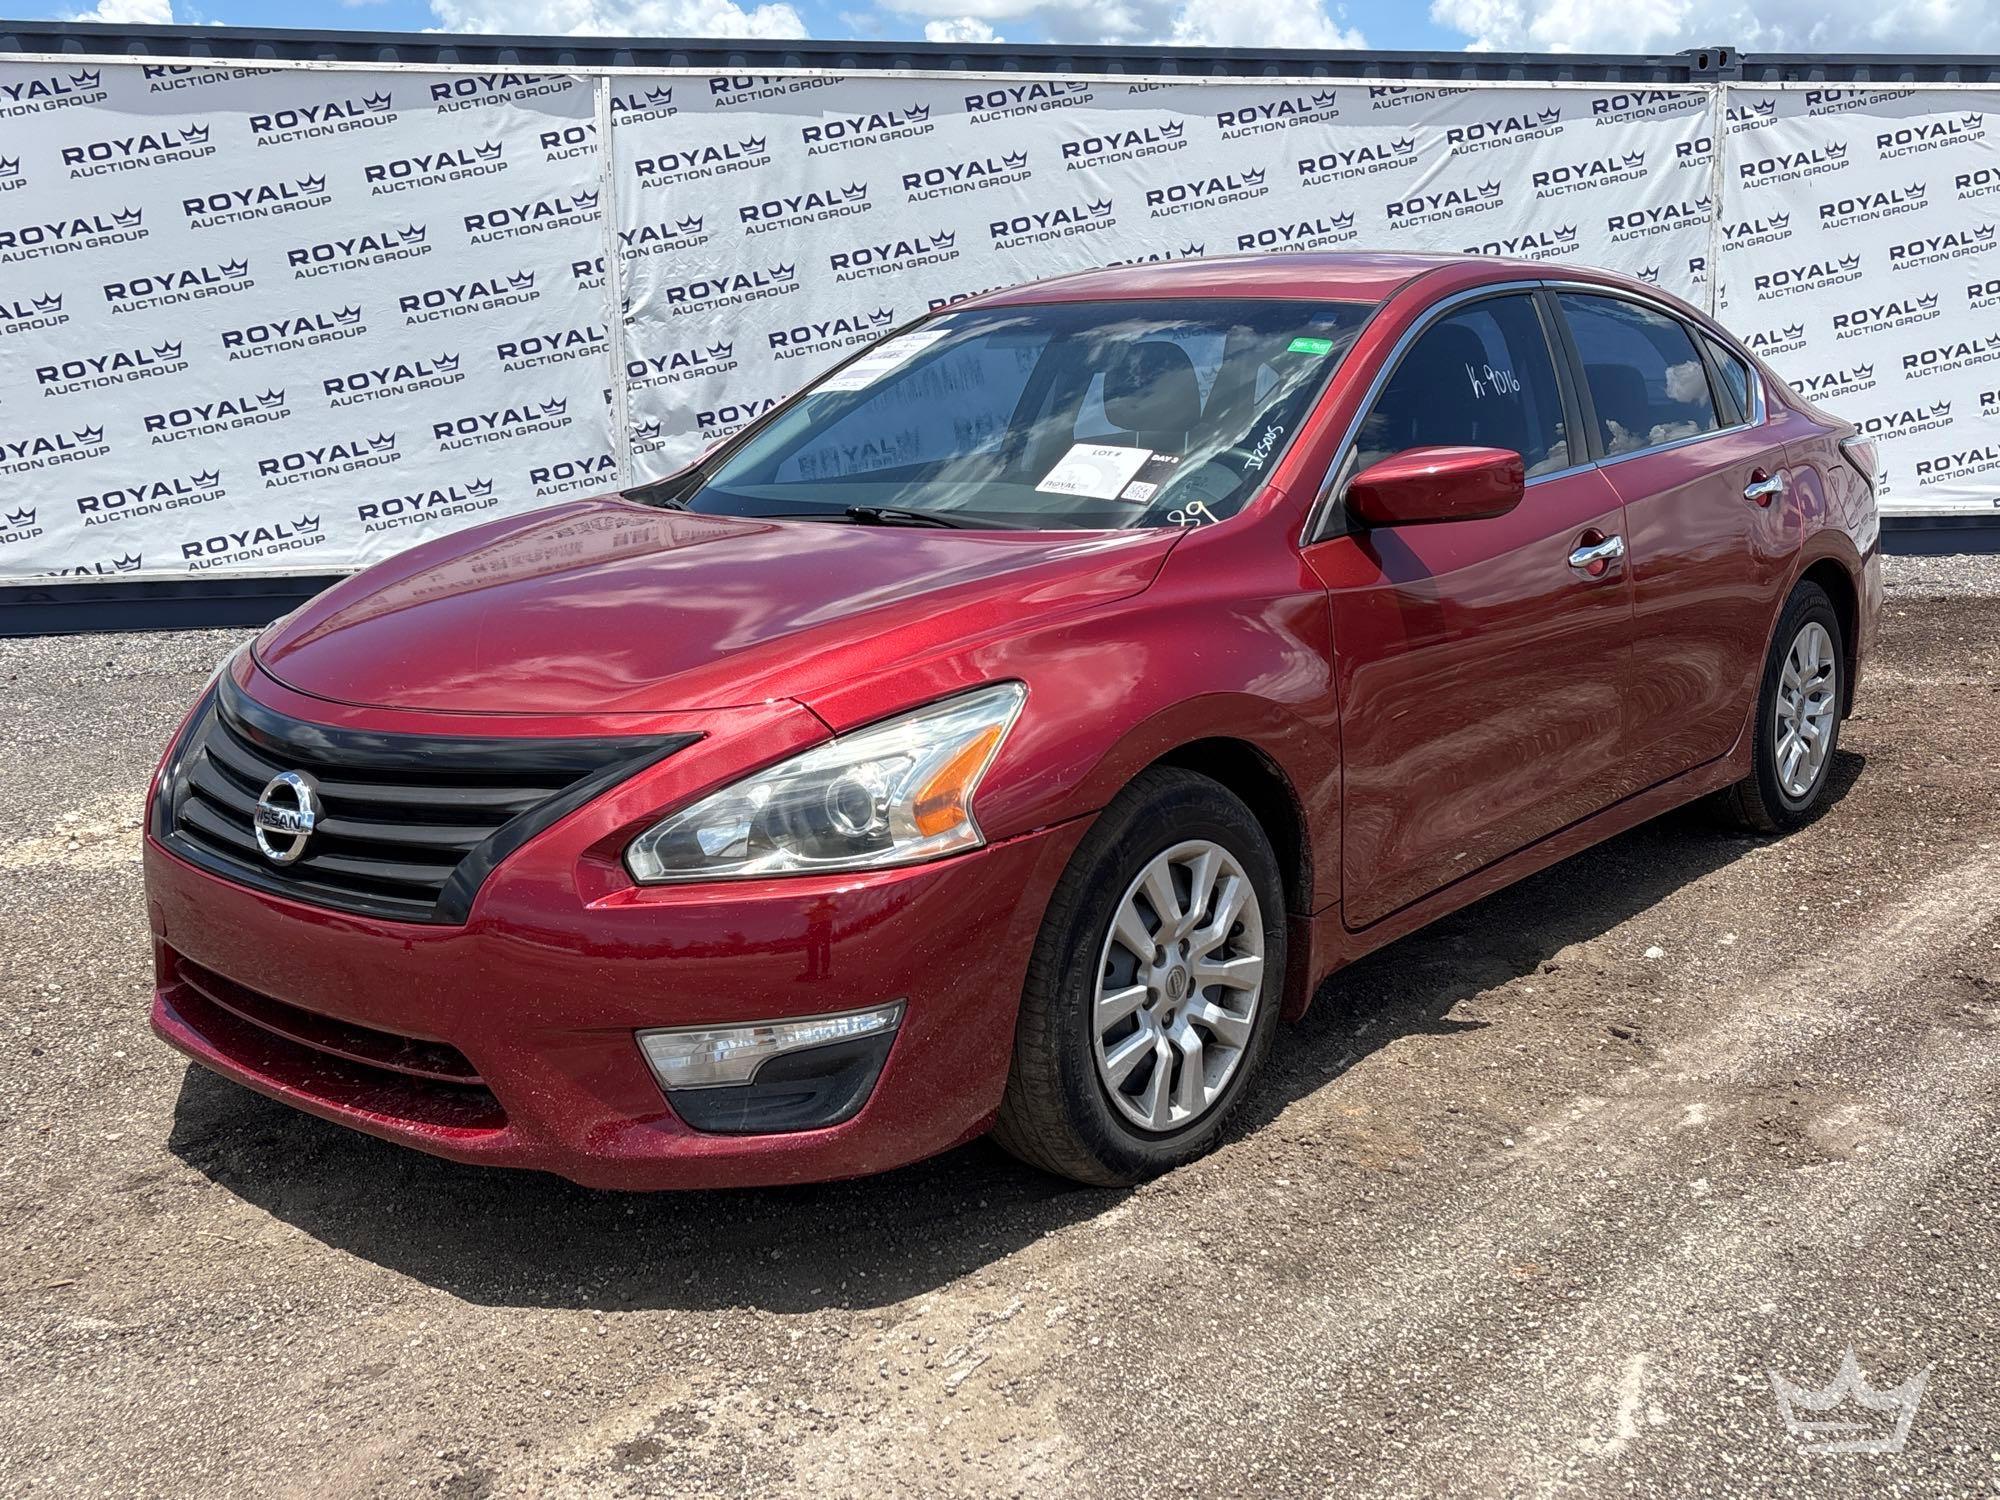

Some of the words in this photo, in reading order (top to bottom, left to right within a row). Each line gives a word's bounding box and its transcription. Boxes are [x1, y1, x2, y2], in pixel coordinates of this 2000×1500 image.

[43, 92, 108, 111] GROUP
[437, 93, 511, 114] AUCTION
[515, 81, 572, 99] GROUP
[715, 86, 787, 107] AUCTION
[965, 81, 1065, 112] ROYAL
[970, 104, 1037, 125] AUCTION
[1040, 94, 1093, 111] GROUP
[1596, 107, 1656, 126] AUCTION
[1659, 97, 1706, 113] GROUP
[1809, 98, 1867, 117] AUCTION
[250, 100, 364, 133] ROYAL
[802, 112, 904, 144] ROYAL
[1217, 98, 1312, 128] ROYAL
[1222, 121, 1286, 140] AUCTION
[1289, 110, 1339, 127] GROUP
[258, 125, 334, 147] AUCTION
[338, 114, 397, 132] GROUP
[808, 135, 877, 156] AUCTION
[880, 124, 934, 142] GROUP
[1062, 128, 1160, 159] ROYAL
[1447, 115, 1537, 145] ROYAL
[1450, 137, 1512, 157] AUCTION
[1515, 126, 1563, 143] GROUP
[1877, 121, 1961, 149] ROYAL
[1880, 141, 1937, 160] AUCTION
[1940, 131, 1985, 147] GROUP
[61, 132, 182, 166] ROYAL
[70, 157, 150, 179] AUCTION
[153, 146, 216, 164] GROUP
[635, 144, 740, 176] ROYAL
[1067, 151, 1132, 171] AUCTION
[1136, 140, 1187, 157] GROUP
[1298, 145, 1391, 175] ROYAL
[1740, 150, 1826, 178] ROYAL
[364, 149, 476, 183] ROYAL
[372, 174, 446, 196] AUCTION
[449, 162, 508, 180] GROUP
[641, 168, 712, 189] AUCTION
[715, 156, 771, 174] GROUP
[902, 159, 1003, 190] ROYAL
[1302, 167, 1365, 187] AUCTION
[1368, 156, 1418, 173] GROUP
[1533, 158, 1622, 188] ROYAL
[1743, 171, 1801, 189] AUCTION
[1804, 160, 1849, 176] GROUP
[183, 183, 298, 216] ROYAL
[908, 182, 975, 203] AUCTION
[979, 171, 1031, 188] GROUP
[1146, 175, 1242, 206] ROYAL
[1536, 180, 1597, 199] AUCTION
[1600, 169, 1647, 185] GROUP
[191, 208, 268, 229] AUCTION
[271, 196, 331, 214] GROUP
[464, 199, 573, 232] ROYAL
[739, 190, 842, 223] ROYAL
[1151, 198, 1215, 218] AUCTION
[1218, 187, 1269, 204] GROUP
[1386, 188, 1478, 219] ROYAL
[1390, 210, 1452, 230] AUCTION
[1455, 200, 1503, 216] GROUP
[1608, 202, 1695, 232] ROYAL
[1819, 190, 1904, 219] ROYAL
[1822, 211, 1880, 230] AUCTION
[1883, 200, 1928, 216] GROUP
[471, 223, 543, 245] AUCTION
[746, 214, 814, 235] AUCTION
[818, 203, 871, 220] GROUP
[990, 207, 1088, 238] ROYAL
[995, 230, 1061, 250] AUCTION
[1064, 219, 1116, 236] GROUP
[1611, 224, 1670, 243] AUCTION
[2, 241, 82, 263] AUCTION
[86, 229, 149, 248] GROUP
[287, 233, 399, 267] ROYAL
[1237, 219, 1331, 251] ROYAL
[1308, 231, 1357, 248] GROUP
[1889, 231, 1973, 261] ROYAL
[295, 257, 370, 280] AUCTION
[373, 245, 431, 264] GROUP
[830, 238, 930, 270] ROYAL
[836, 262, 903, 283] AUCTION
[906, 250, 959, 268] GROUP
[1893, 252, 1949, 271] AUCTION
[1952, 242, 1997, 257] GROUP
[103, 267, 221, 301] ROYAL
[666, 271, 770, 304] ROYAL
[1754, 262, 1838, 290] ROYAL
[1758, 282, 1814, 301] AUCTION
[1817, 272, 1862, 288] GROUP
[112, 292, 190, 314] AUCTION
[193, 280, 254, 299] GROUP
[399, 279, 508, 313] ROYAL
[406, 303, 479, 325] AUCTION
[482, 291, 540, 310] GROUP
[673, 295, 742, 316] AUCTION
[745, 283, 800, 301] GROUP
[6, 315, 69, 334] GROUP
[1833, 300, 1917, 329] ROYAL
[1836, 321, 1893, 340] AUCTION
[1896, 310, 1940, 326] GROUP
[221, 314, 334, 348] ROYAL
[229, 338, 305, 361] AUCTION
[308, 326, 367, 345] GROUP
[497, 327, 604, 360] ROYAL
[768, 316, 869, 348] ROYAL
[504, 350, 575, 372] AUCTION
[774, 339, 842, 360] AUCTION
[1903, 340, 1985, 369] ROYAL
[36, 350, 154, 384] ROYAL
[44, 374, 124, 397] AUCTION
[127, 362, 188, 381] GROUP
[323, 362, 433, 396] ROYAL
[1906, 361, 1962, 380] AUCTION
[330, 386, 404, 408] AUCTION
[407, 373, 465, 392] GROUP
[144, 398, 258, 432] ROYAL
[152, 422, 228, 445] AUCTION
[231, 409, 291, 428] GROUP
[433, 406, 541, 439] ROYAL
[440, 430, 512, 452] AUCTION
[515, 417, 572, 436] GROUP
[48, 446, 110, 466] GROUP
[258, 442, 369, 476] ROYAL
[266, 465, 340, 488] AUCTION
[343, 453, 401, 472] GROUP
[1916, 447, 1998, 476] ROYAL
[536, 475, 607, 497] AUCTION
[1044, 481, 1077, 489] ROYAL
[1920, 467, 1975, 486] AUCTION
[77, 479, 193, 514] ROYAL
[85, 503, 162, 527] AUCTION
[166, 490, 225, 509] GROUP
[358, 487, 467, 521] ROYAL
[365, 511, 438, 533] AUCTION
[441, 498, 498, 516] GROUP
[181, 524, 293, 559] ROYAL
[189, 548, 263, 571] AUCTION
[267, 535, 325, 554] GROUP
[257, 810, 301, 829] NISSAN
